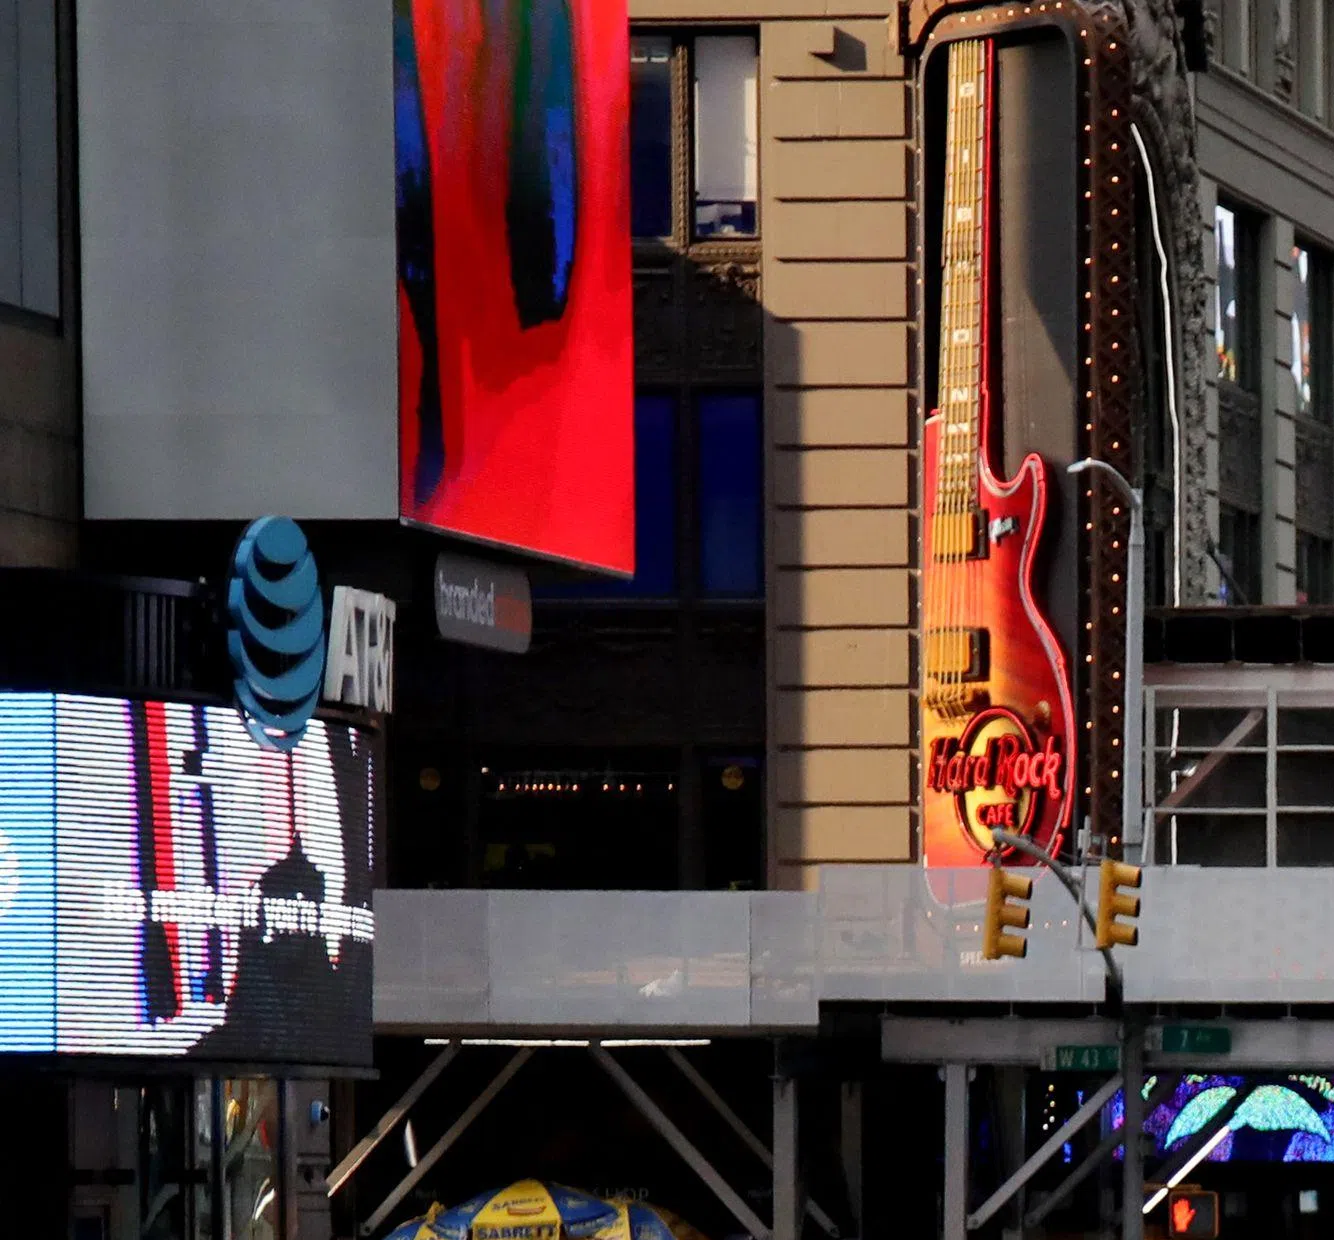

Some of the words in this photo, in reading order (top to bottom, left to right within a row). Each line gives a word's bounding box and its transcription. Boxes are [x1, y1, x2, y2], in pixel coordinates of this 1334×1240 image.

[927, 736, 998, 793] Hard
[995, 733, 1062, 799] Rock
[976, 803, 1015, 826] CAFE
[1080, 1048, 1099, 1070] 43
[477, 1225, 557, 1240] SABRETT
